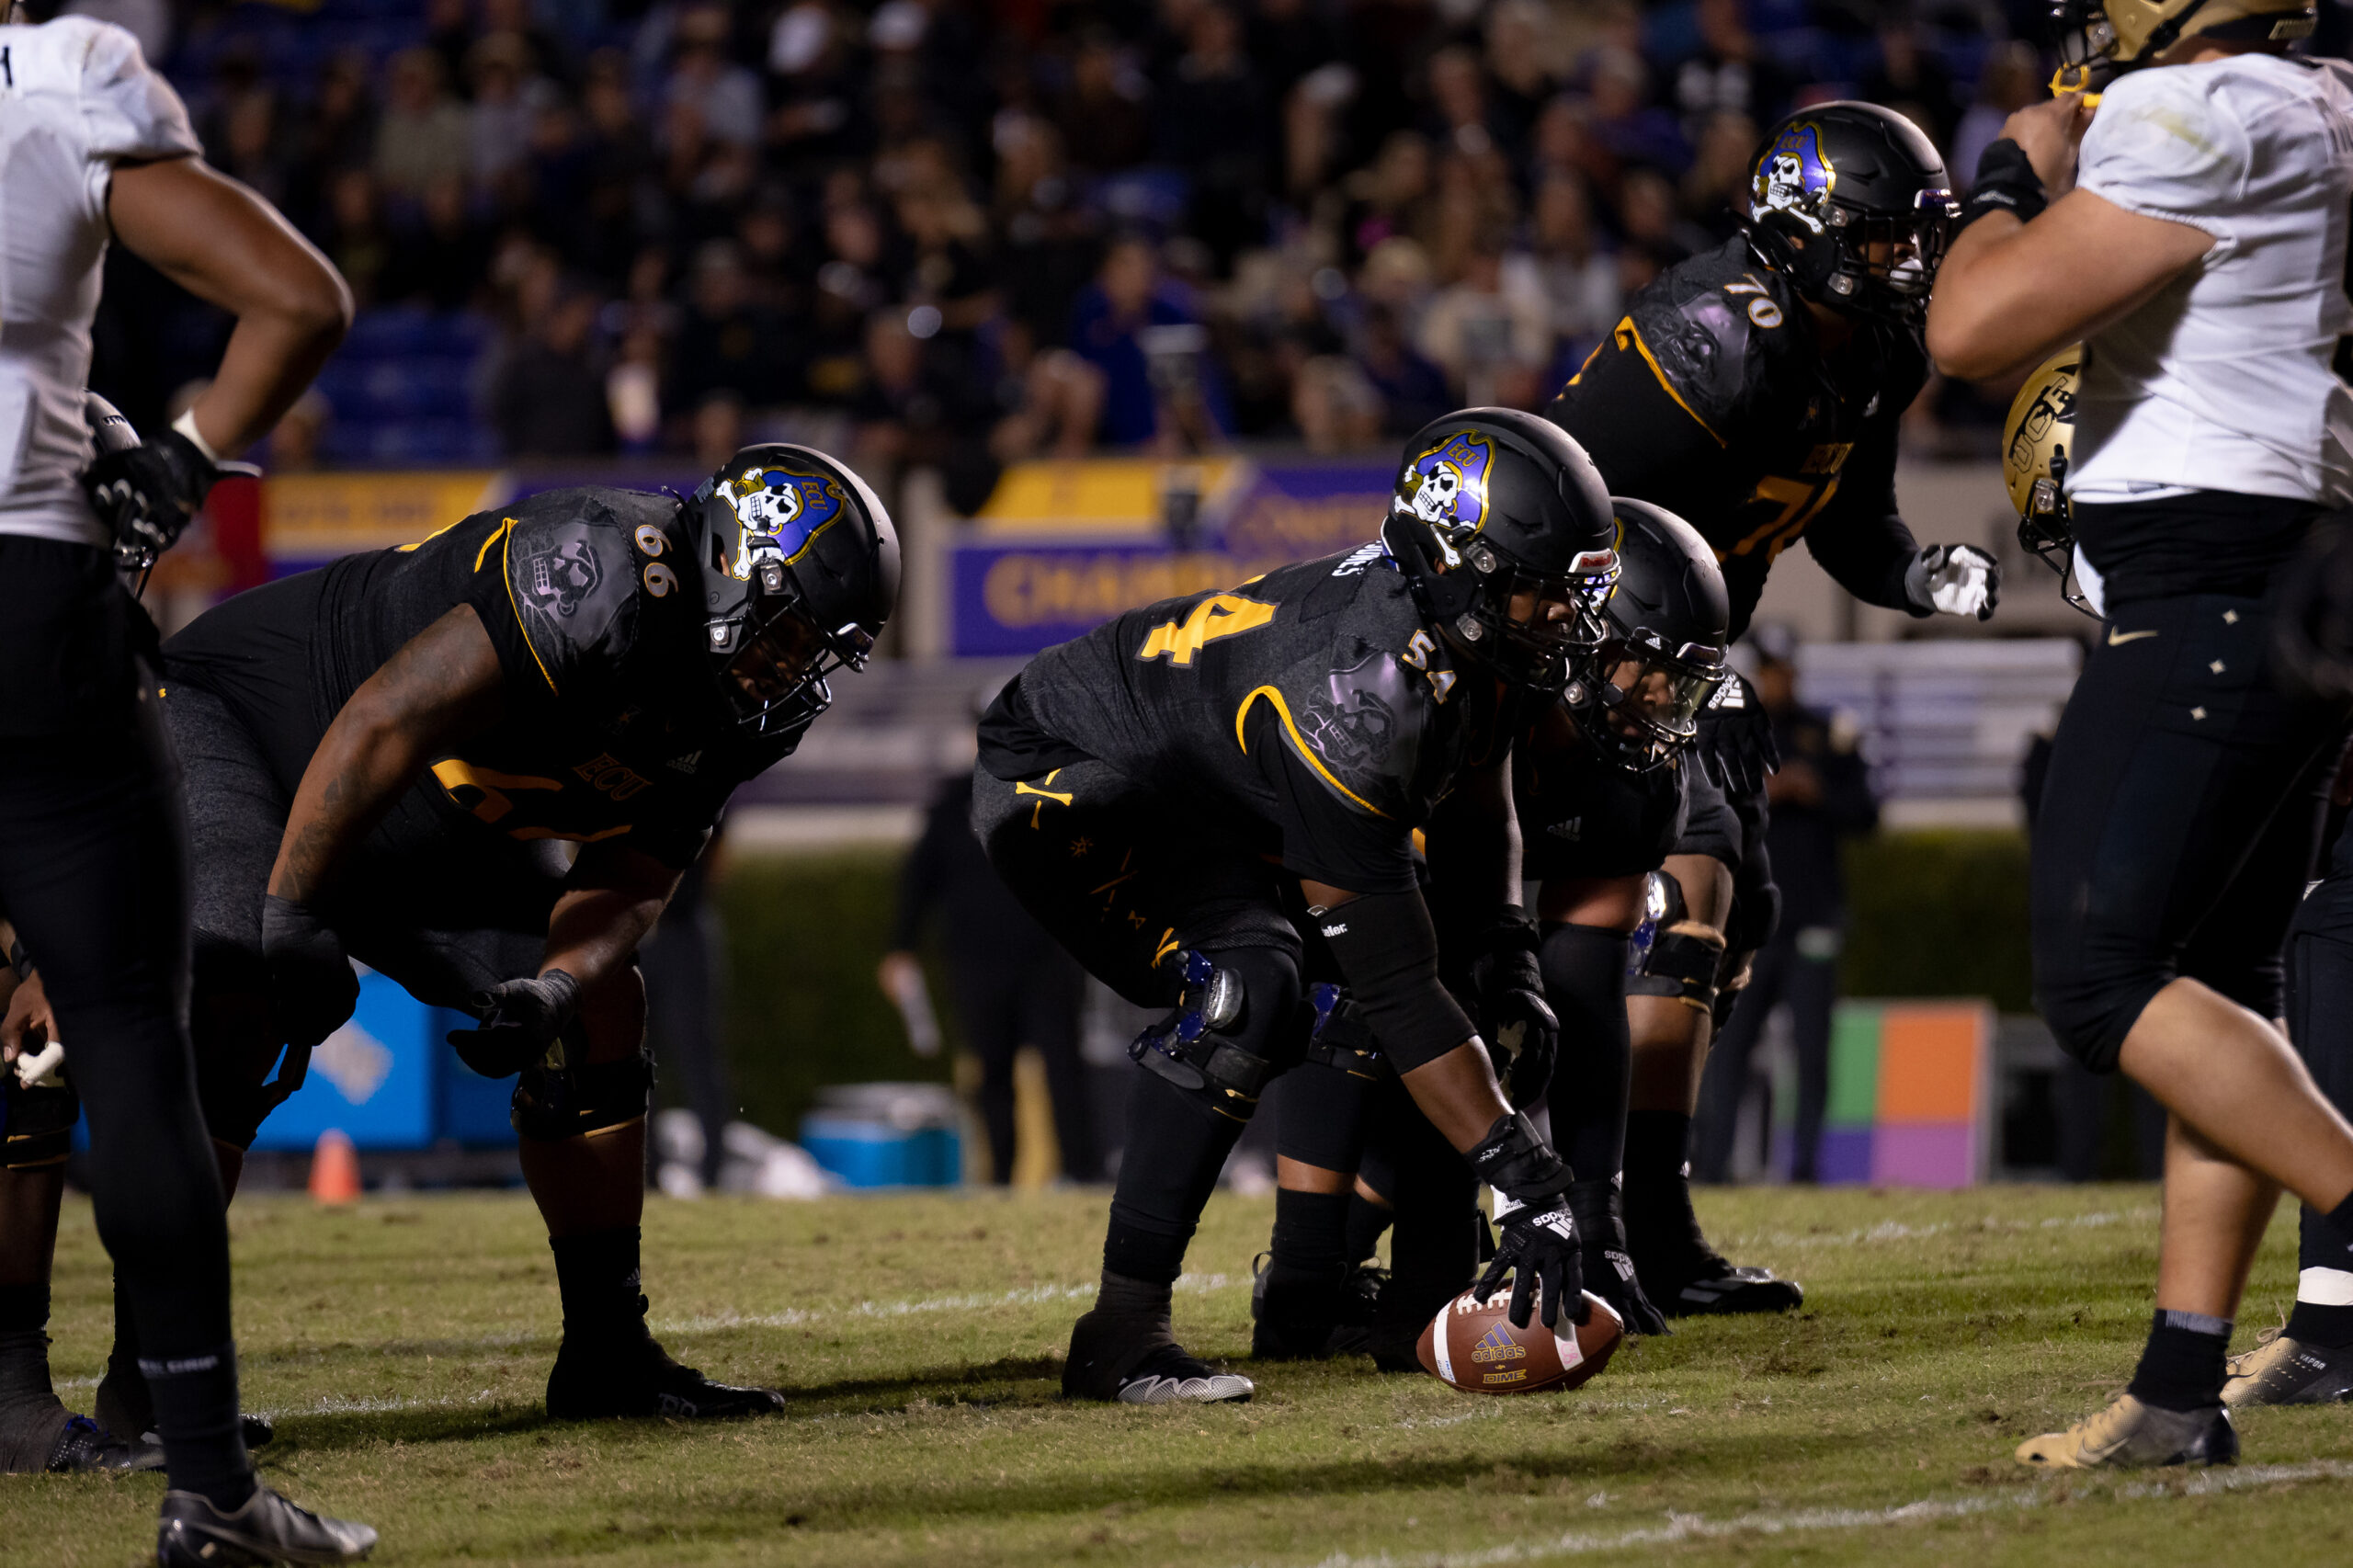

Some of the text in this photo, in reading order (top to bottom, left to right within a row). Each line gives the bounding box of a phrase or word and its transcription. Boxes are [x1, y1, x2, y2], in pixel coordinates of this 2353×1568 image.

[1723, 272, 1784, 329] 70
[2009, 376, 2075, 474] UCF
[1447, 442, 1481, 467] ECU
[801, 482, 828, 510] ECU
[635, 524, 680, 598] 66
[1402, 629, 1458, 706] 54
[569, 751, 654, 801] ECU
[1472, 1346, 1527, 1363] adidas
[2299, 1353, 2327, 1371] VAPOR
[1483, 1369, 1528, 1384] DIME
